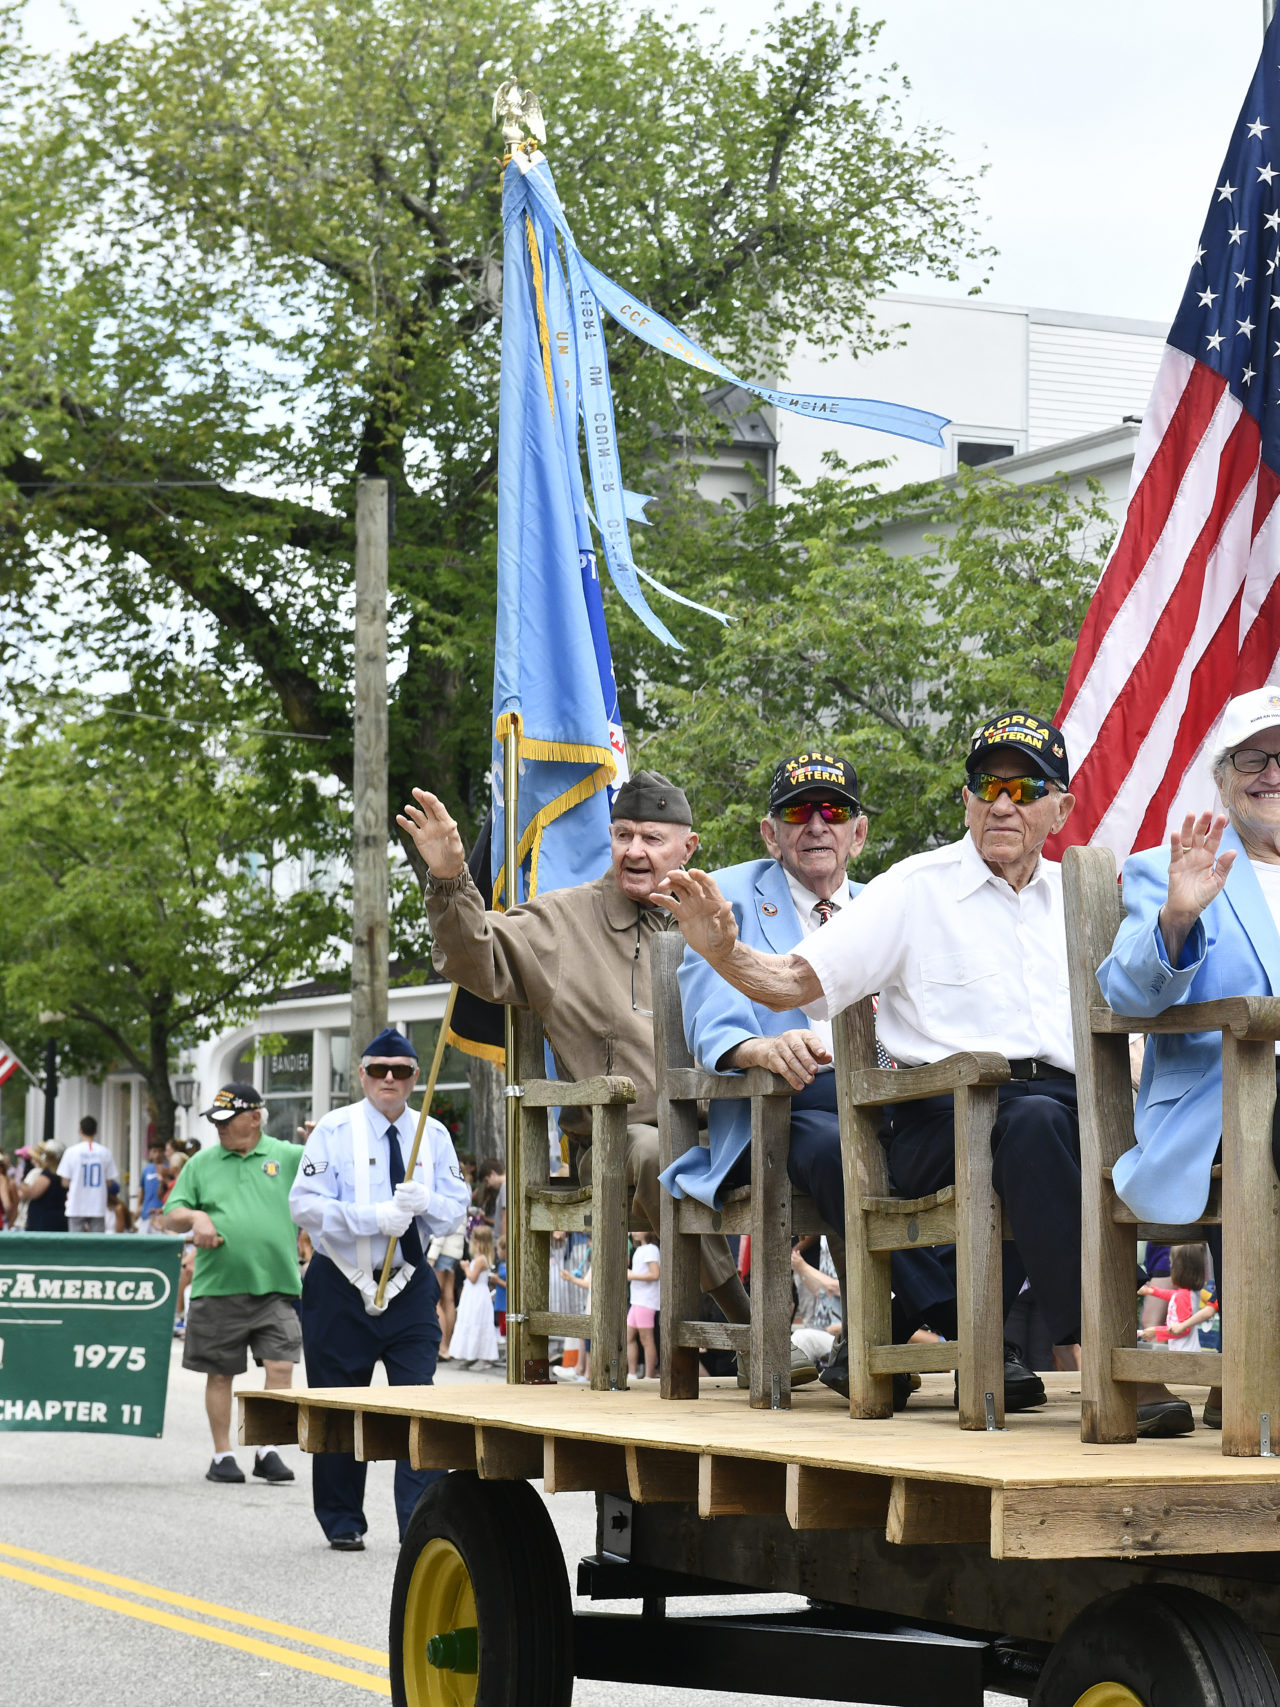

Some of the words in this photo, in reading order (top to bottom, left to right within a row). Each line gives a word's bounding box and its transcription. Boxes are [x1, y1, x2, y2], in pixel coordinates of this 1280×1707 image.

[620, 304, 651, 327] CCF
[983, 714, 1050, 741] KOREA
[987, 731, 1043, 750] VETERAN
[785, 752, 845, 772] KOREA
[789, 770, 846, 786] VETERAN
[272, 1053, 309, 1073] BANDIER
[82, 1162, 102, 1188] 10
[73, 1344, 146, 1371] 1975
[121, 1404, 142, 1425] 11
